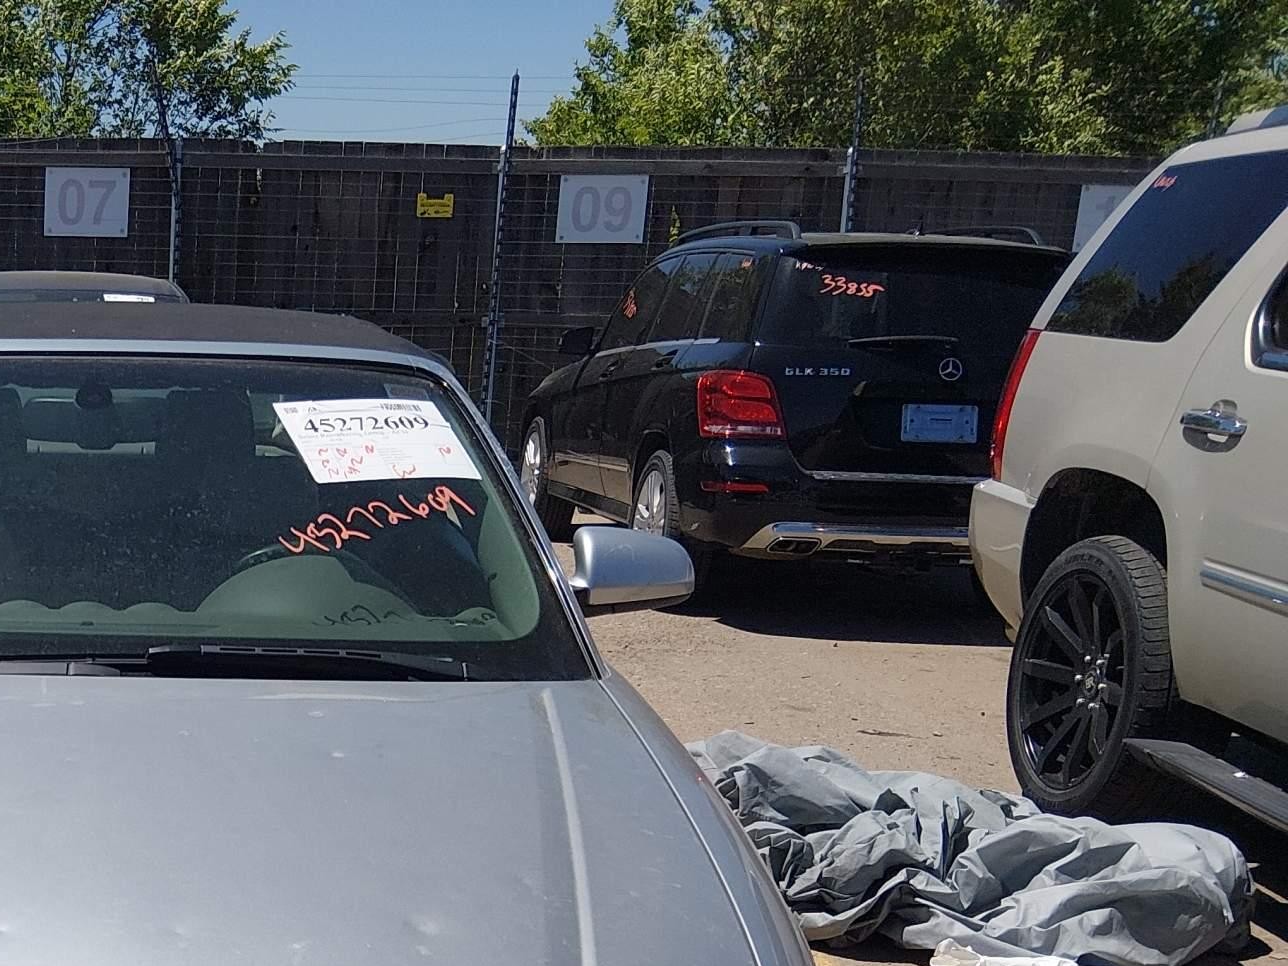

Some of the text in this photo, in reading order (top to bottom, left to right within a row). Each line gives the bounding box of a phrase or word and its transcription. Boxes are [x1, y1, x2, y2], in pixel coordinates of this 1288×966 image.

[58, 178, 117, 226] 07
[572, 186, 632, 233] 09
[785, 367, 851, 376] GLK 350
[304, 415, 429, 433] 45272609
